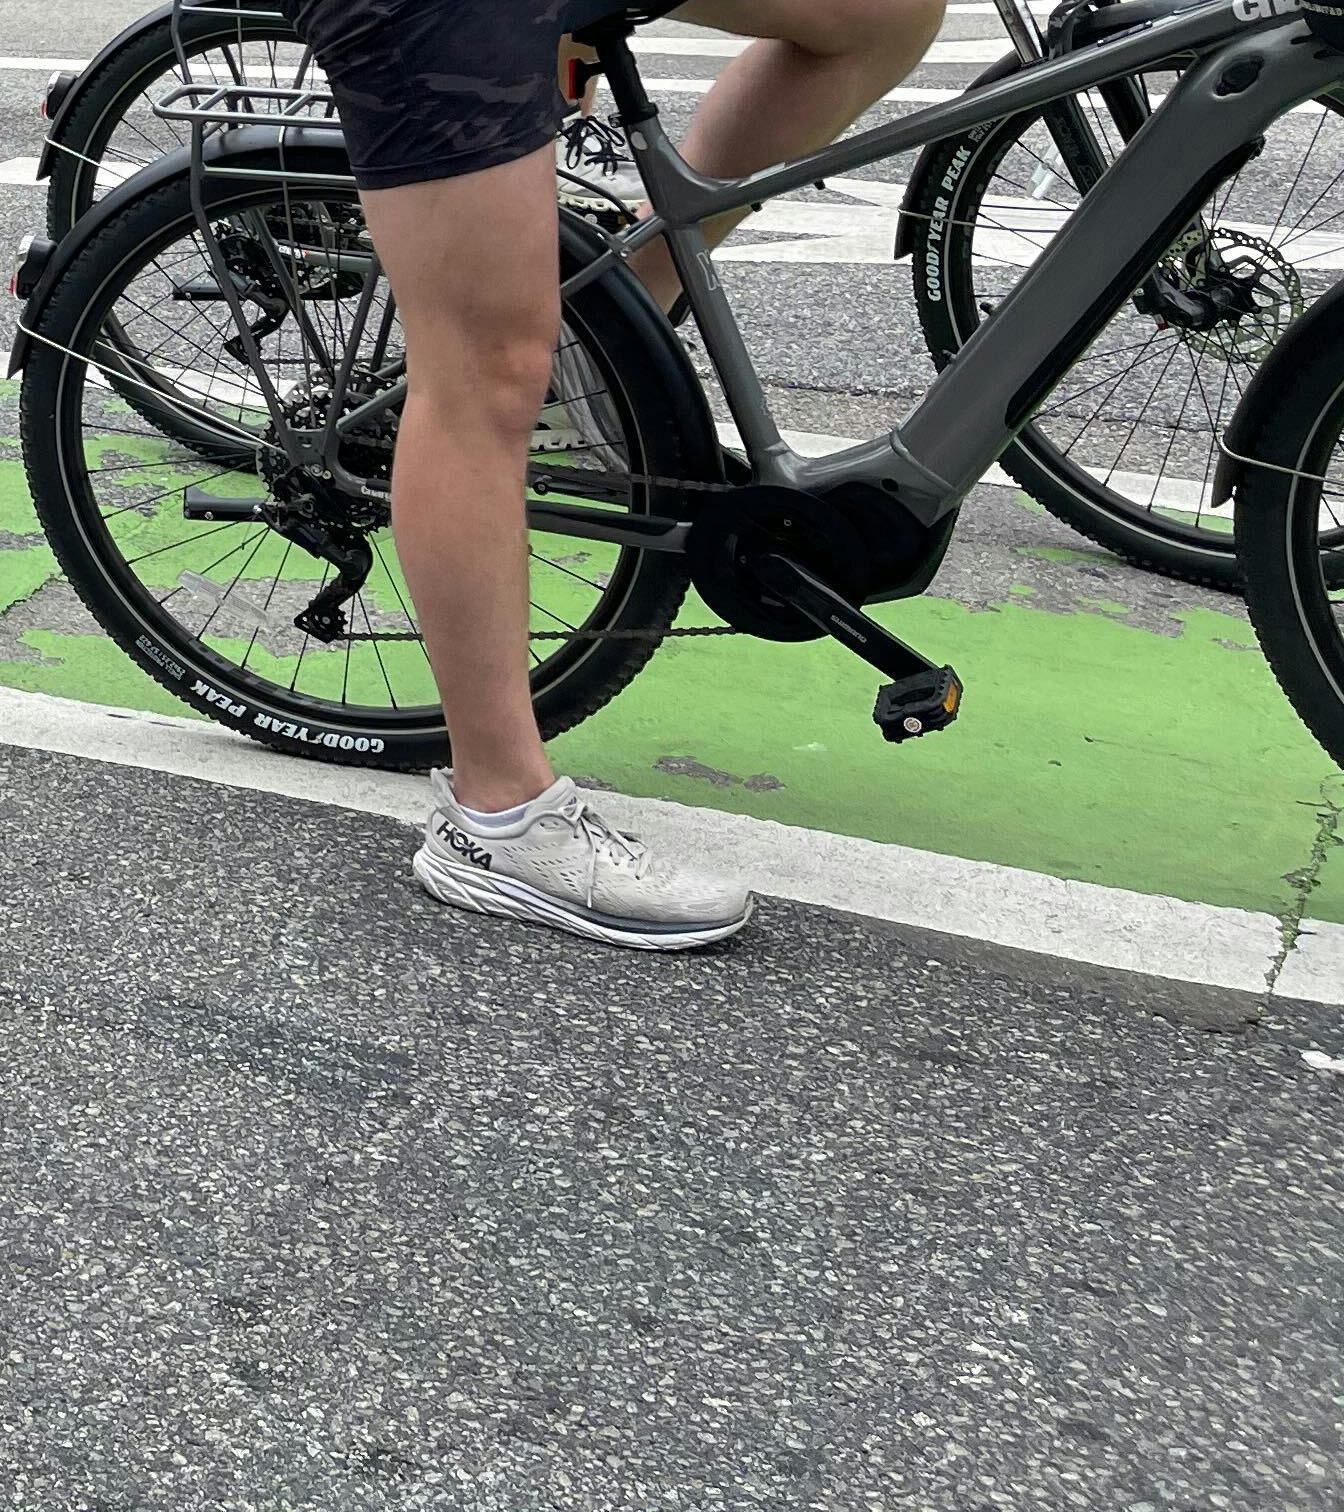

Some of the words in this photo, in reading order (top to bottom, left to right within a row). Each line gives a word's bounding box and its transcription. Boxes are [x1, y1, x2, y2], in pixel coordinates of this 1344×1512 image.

[940, 145, 972, 191] PEAK
[190, 679, 248, 718] PEAK
[253, 712, 385, 754] GOODYEAR
[436, 821, 492, 870] HOKA
